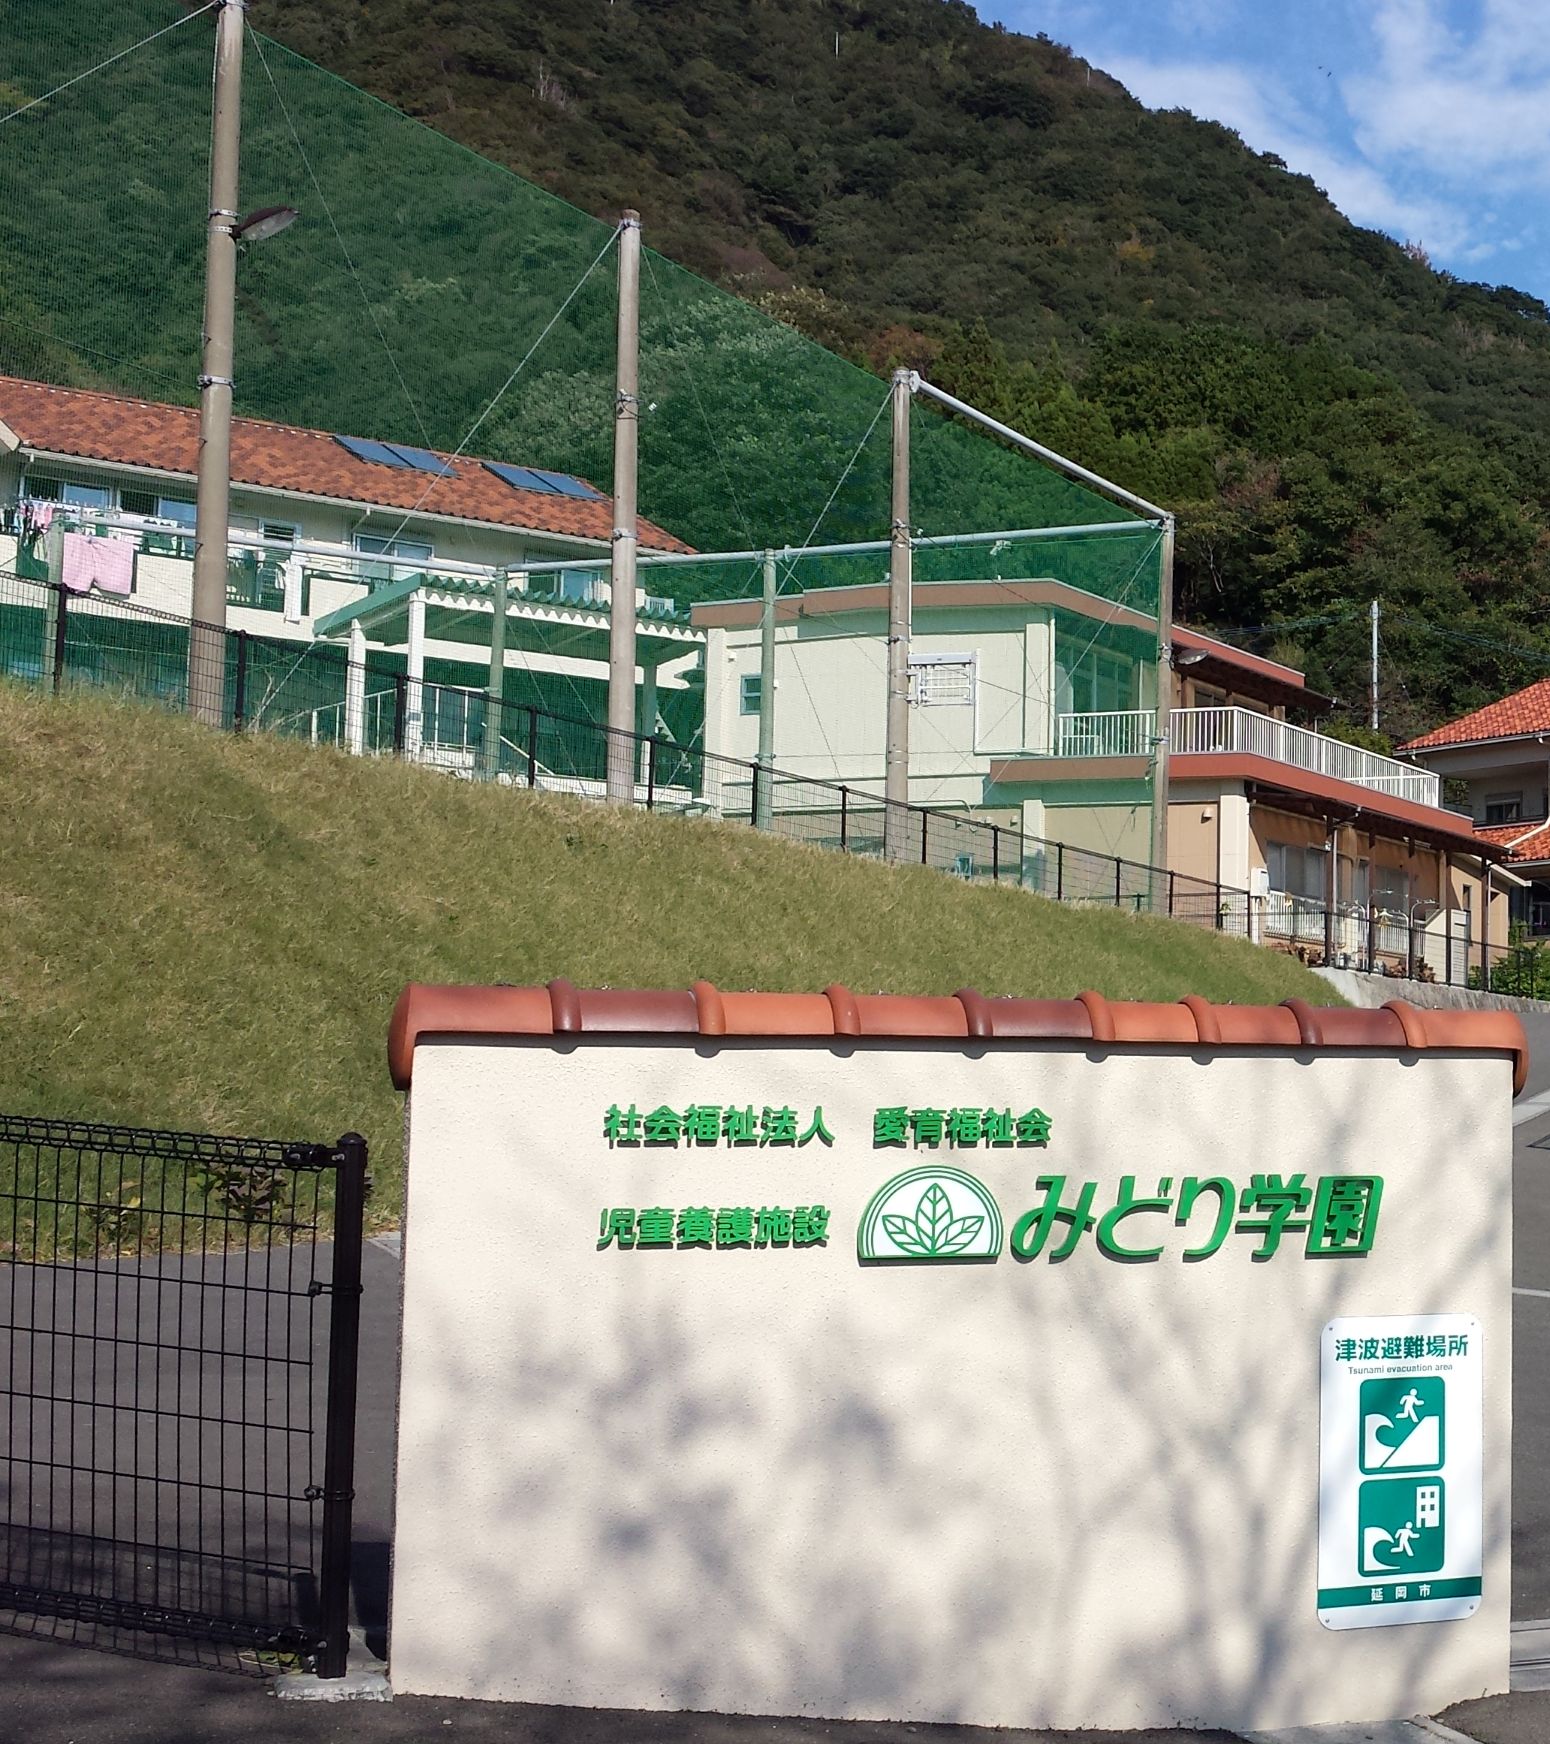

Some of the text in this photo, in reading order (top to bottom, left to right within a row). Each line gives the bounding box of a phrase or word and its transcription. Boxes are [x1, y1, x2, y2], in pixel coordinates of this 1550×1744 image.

[604, 1103, 1053, 1148] 社会福祉法人 愛育福祉会
[597, 1173, 1385, 1262] 児童養護施設 みどり学園
[1335, 1334, 1469, 1362] 津波避難場所
[1347, 1363, 1454, 1375] Tsunami evacuation area
[1370, 1583, 1432, 1602] 延岡市
